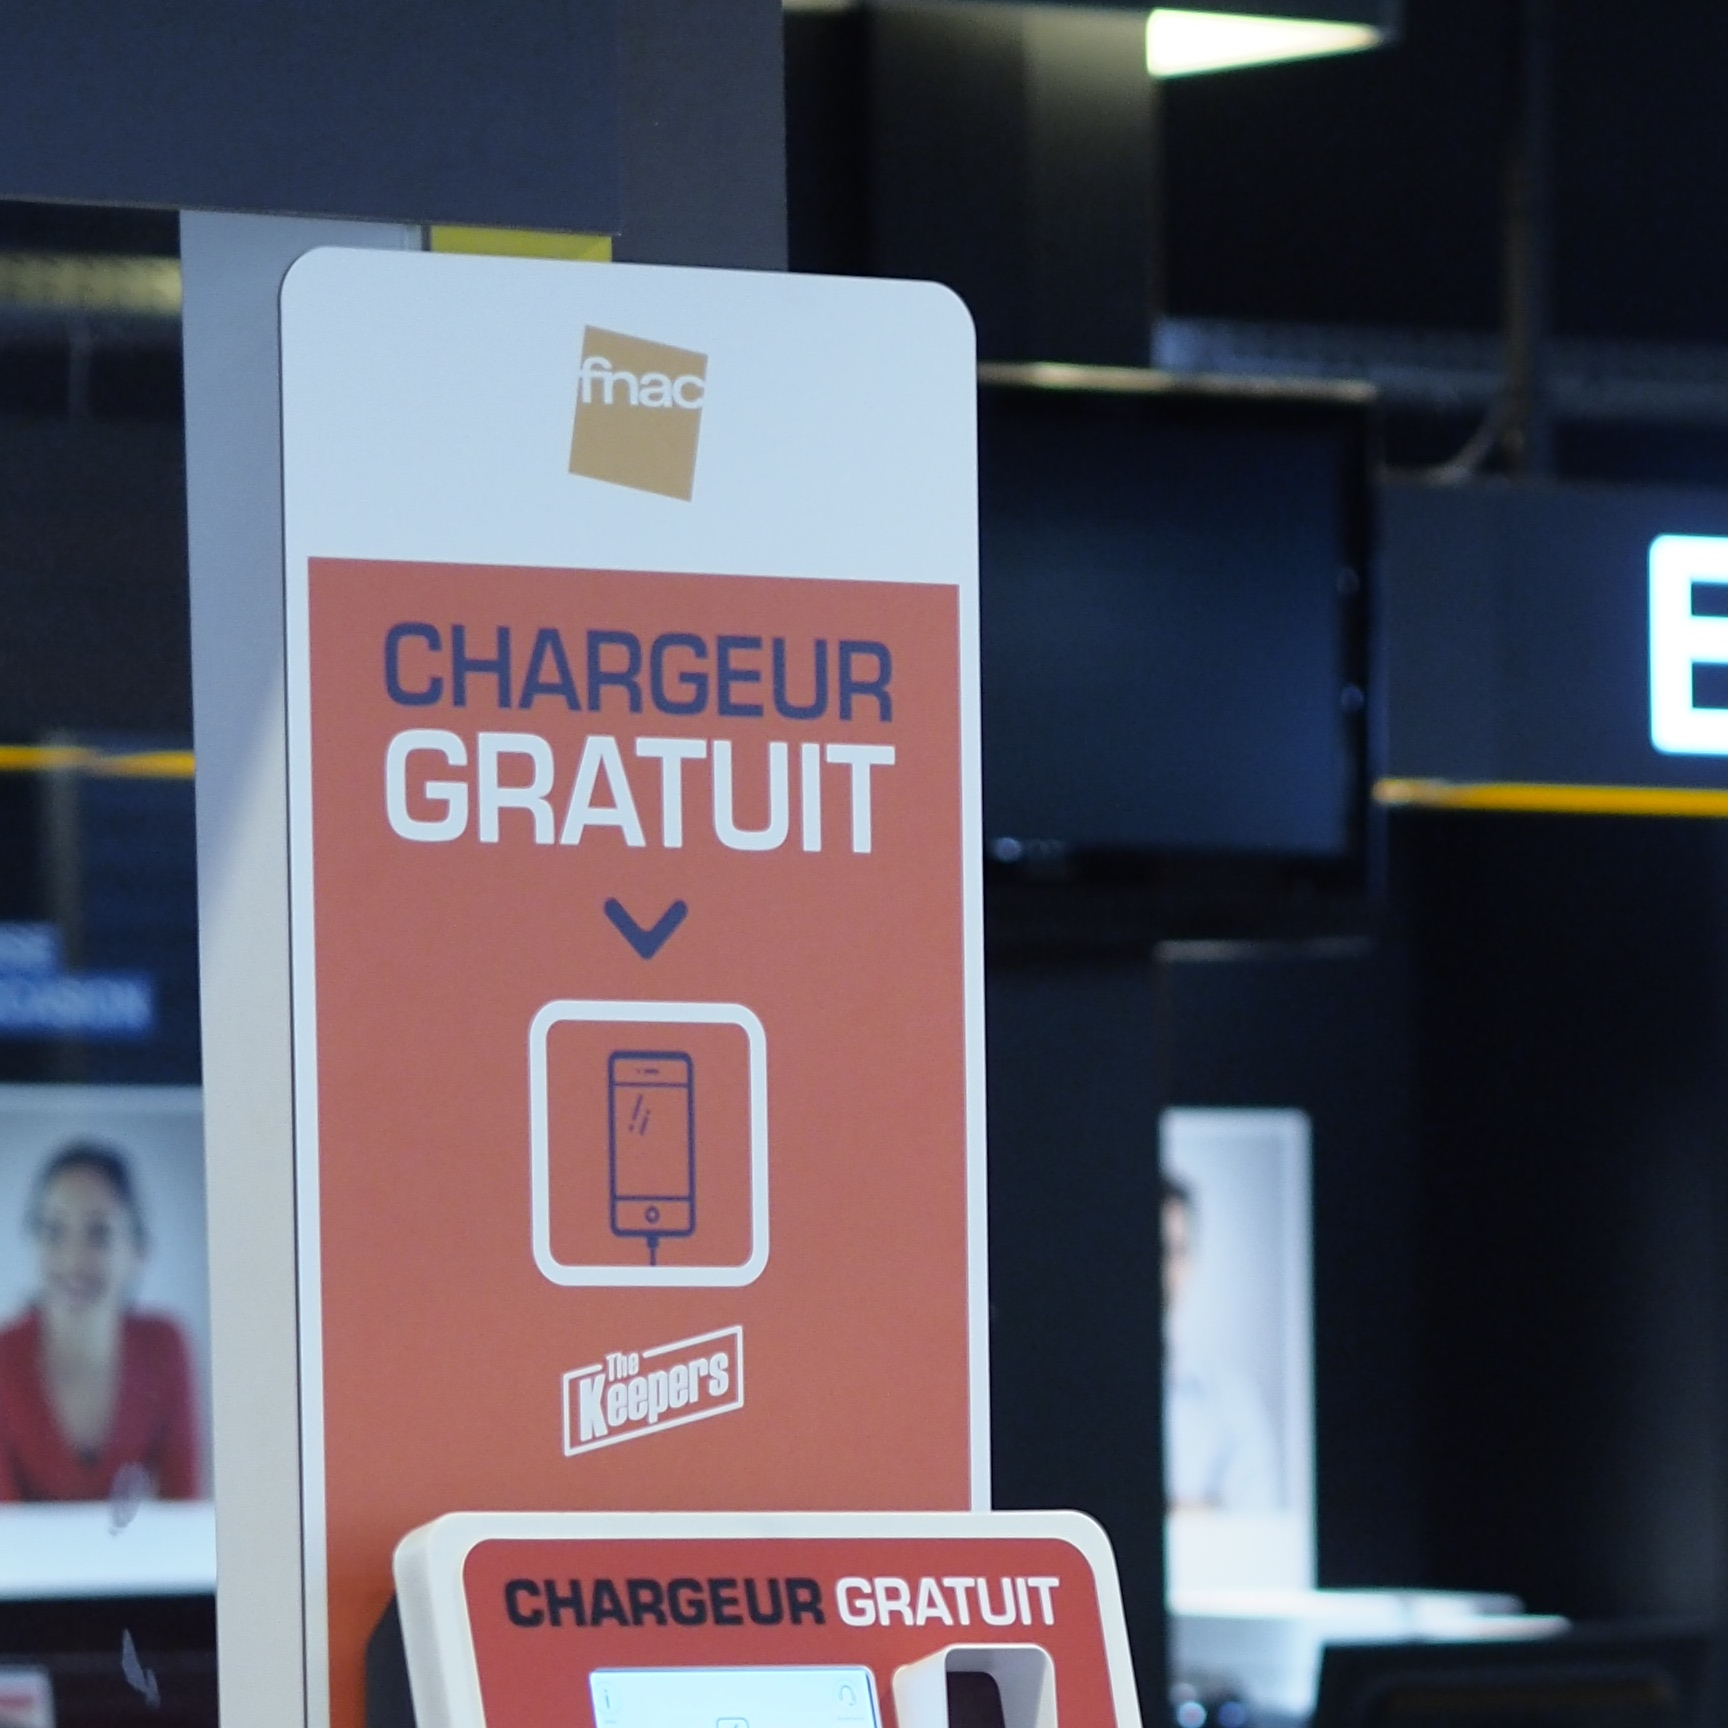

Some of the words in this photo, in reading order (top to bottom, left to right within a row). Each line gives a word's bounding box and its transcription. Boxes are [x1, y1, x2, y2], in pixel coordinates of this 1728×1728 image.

[579, 356, 707, 409] fnac
[384, 621, 893, 722] CHARGEUR
[385, 728, 894, 855] GRATUIT
[579, 1352, 729, 1442] Keepers
[606, 1352, 639, 1381] The
[505, 1576, 825, 1628] CHARGEUR
[835, 1575, 1060, 1627] GRATUIT
